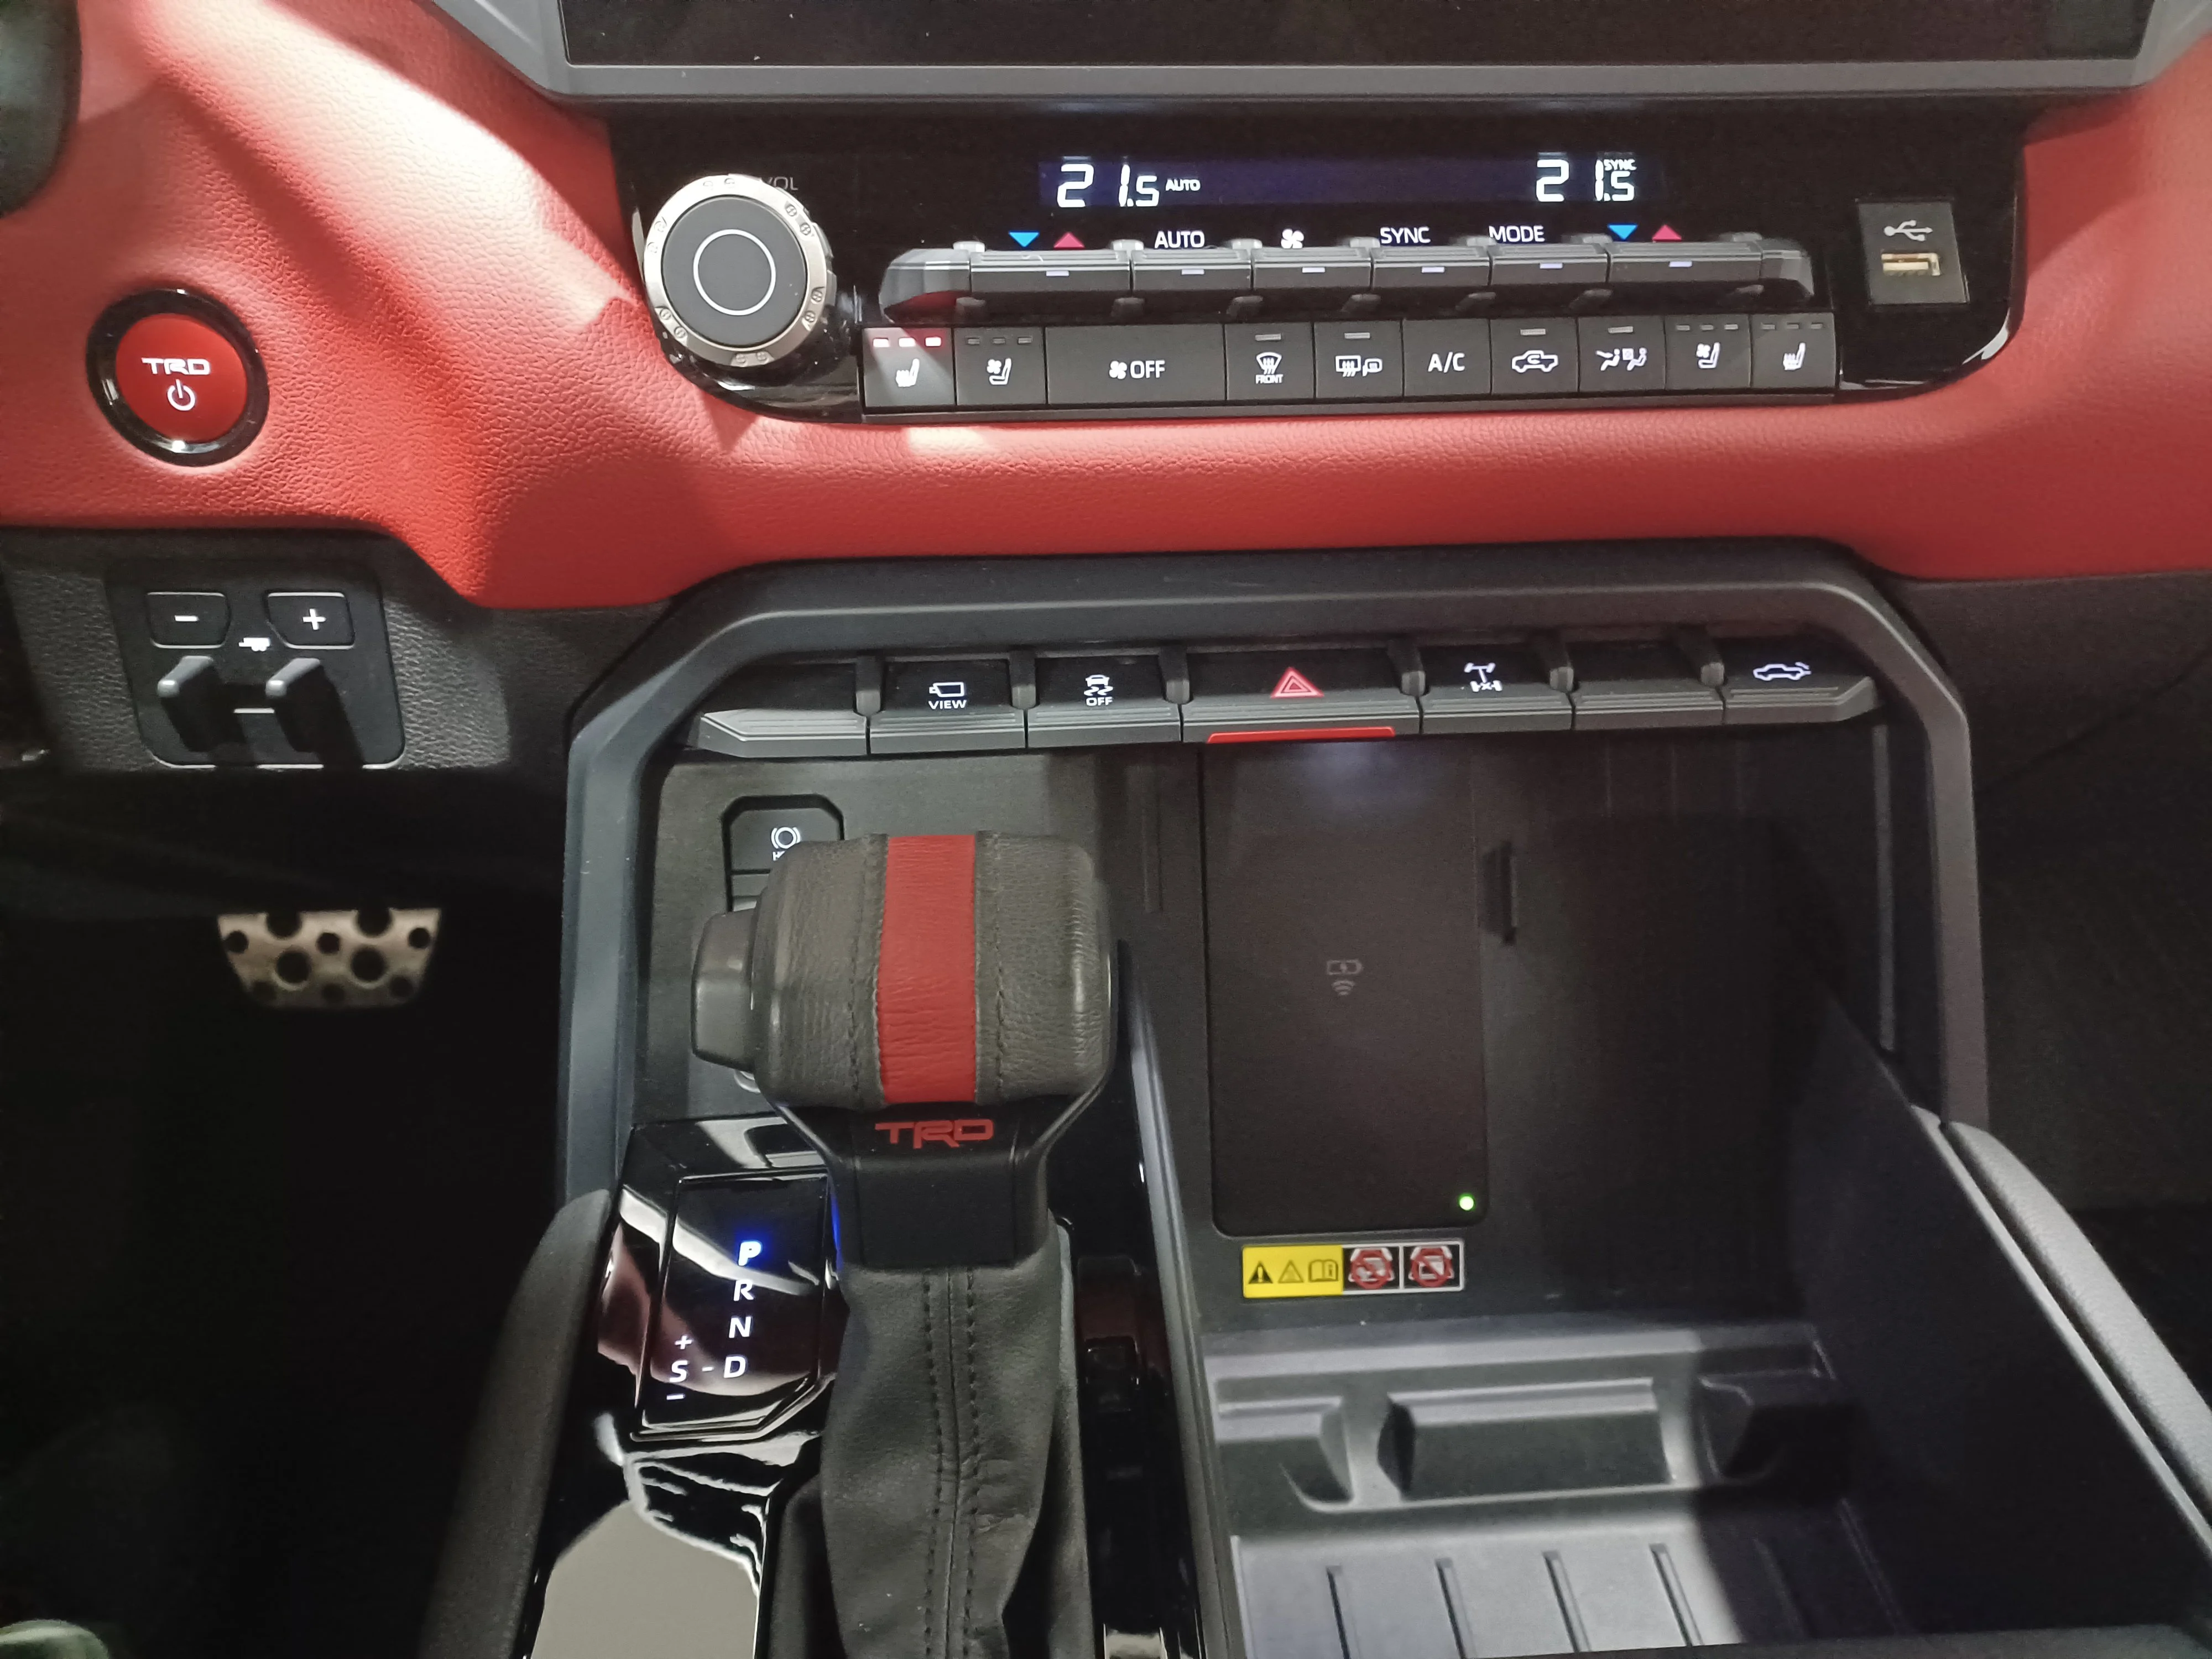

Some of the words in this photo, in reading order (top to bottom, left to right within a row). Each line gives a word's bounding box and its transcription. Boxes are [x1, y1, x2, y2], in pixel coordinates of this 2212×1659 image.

[1603, 158, 1637, 171] SYNC
[1057, 164, 1160, 207] 21.5
[1165, 179, 1201, 191] AUTO
[1536, 159, 1635, 202] 21.5
[1154, 231, 1205, 248] AUTO
[1380, 226, 1431, 244] SYNC
[1488, 225, 1545, 243] MODE
[141, 357, 211, 375] TRD
[1130, 359, 1165, 379] OFF
[1428, 352, 1465, 373] A/C
[1255, 374, 1283, 384] FRONT
[928, 700, 967, 709] VIEW
[1086, 696, 1113, 707] OFF
[875, 1118, 993, 1149] TRD
[738, 1240, 763, 1267] P
[733, 1279, 754, 1302] R
[728, 1316, 752, 1339] N
[669, 1360, 689, 1383] S
[723, 1355, 747, 1379] D
